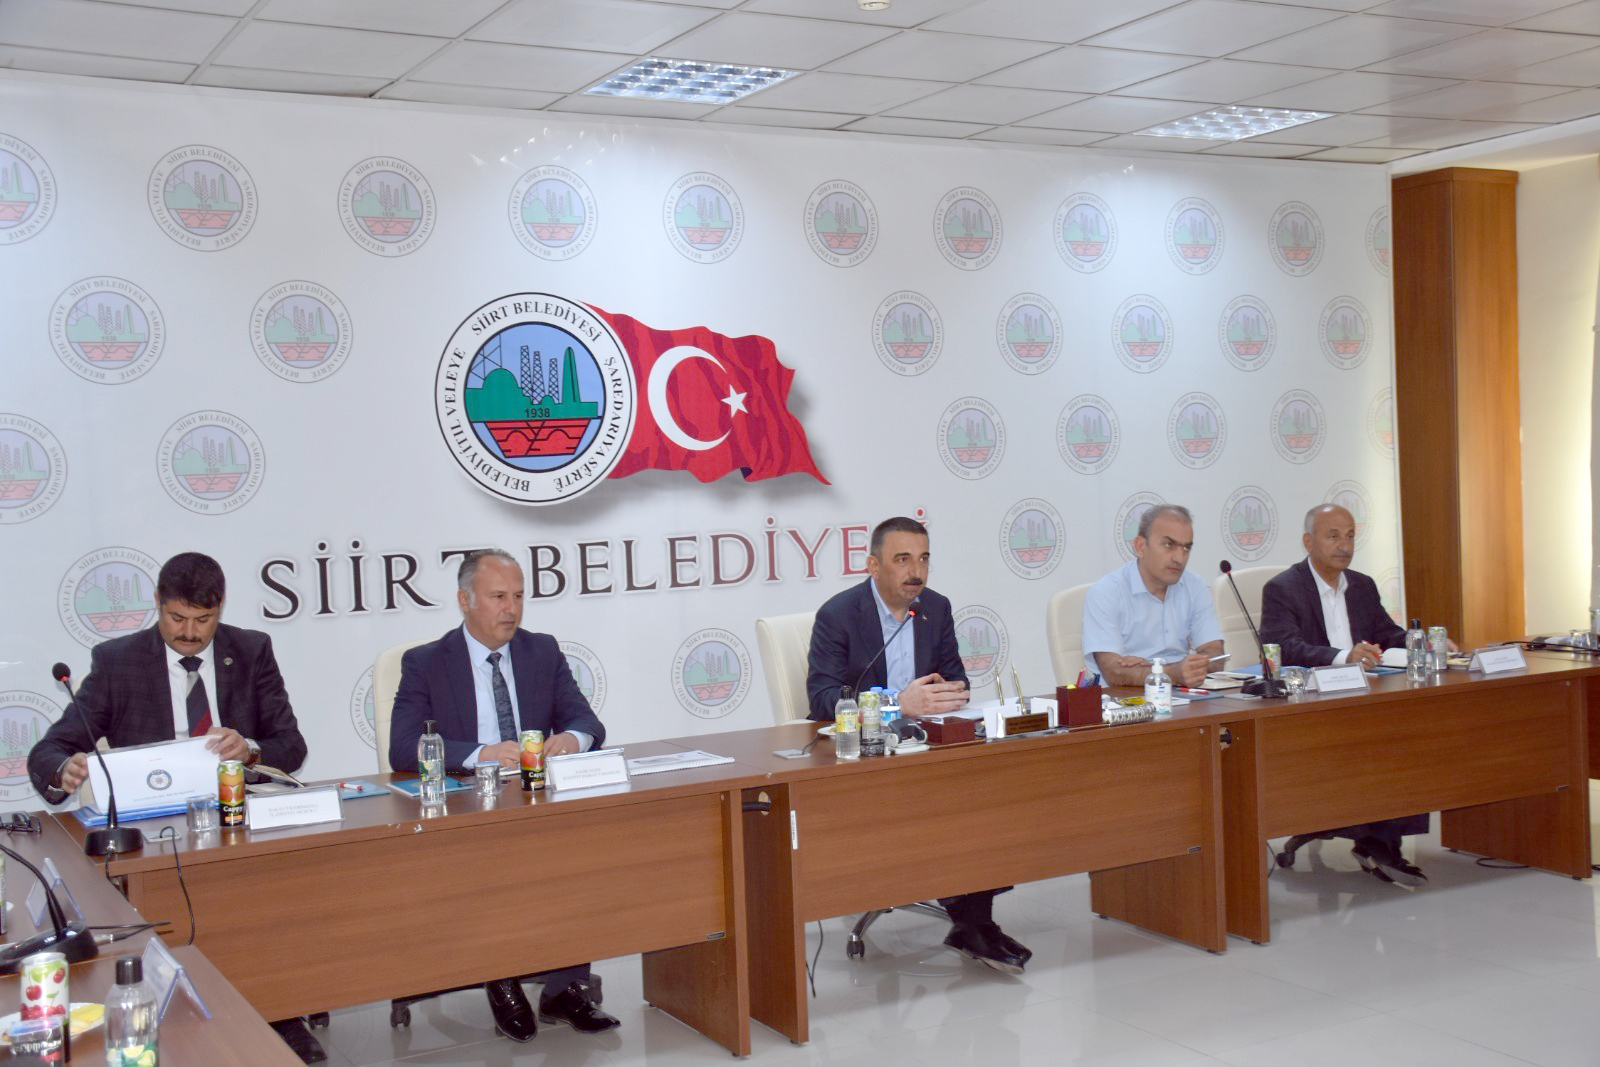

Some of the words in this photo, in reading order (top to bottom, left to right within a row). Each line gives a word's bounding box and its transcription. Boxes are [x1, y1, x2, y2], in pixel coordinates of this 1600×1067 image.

[471, 305, 508, 336] SİİRT
[512, 301, 602, 342] BELEDİYESİ
[444, 347, 466, 416] VELEYE
[595, 356, 623, 456] ŞAREDARIYA
[524, 407, 550, 418] 1938
[553, 457, 598, 493] SÊRTÊ
[528, 509, 927, 599] BELEDİYE
